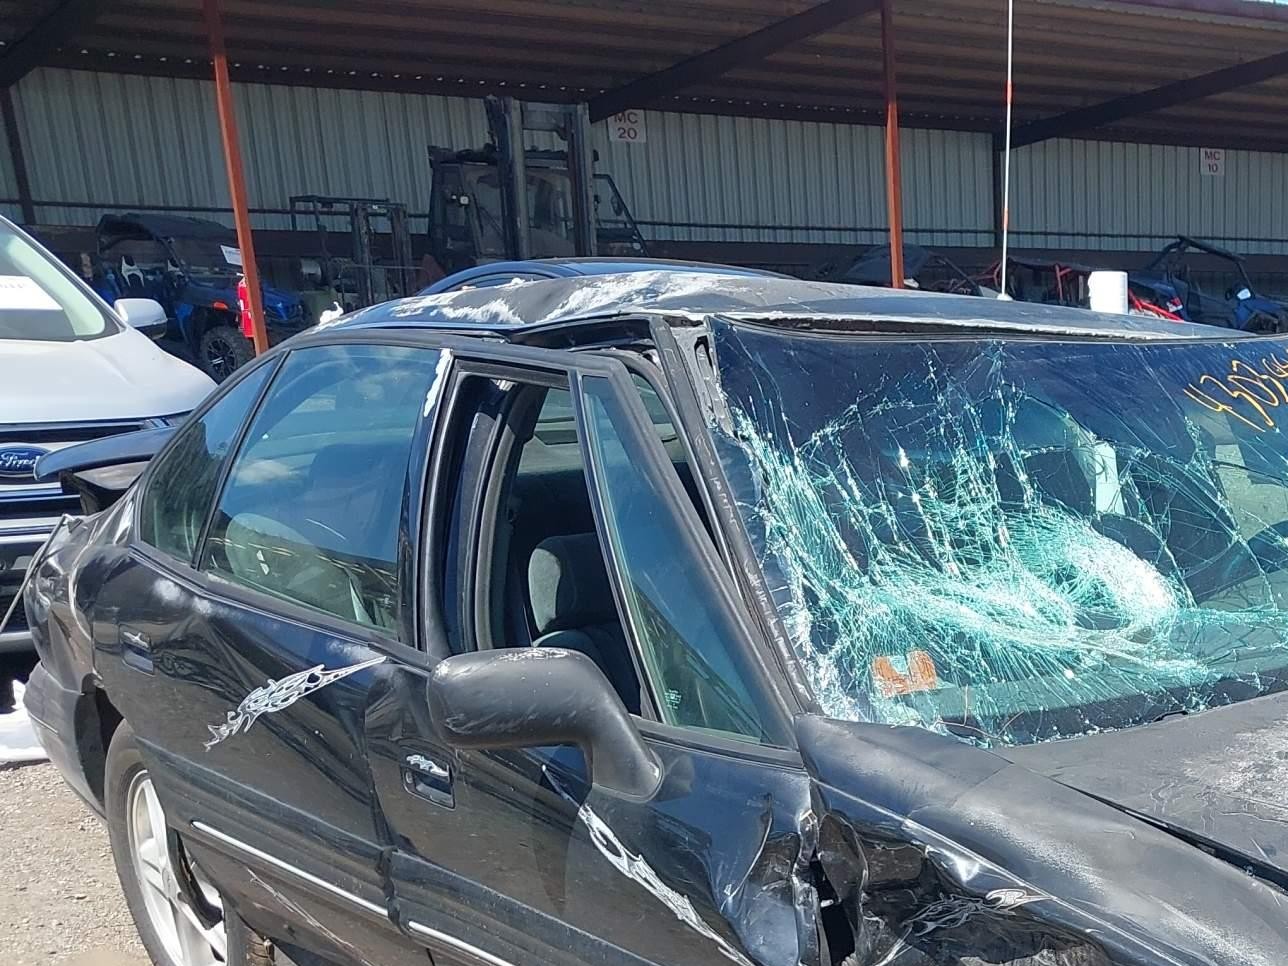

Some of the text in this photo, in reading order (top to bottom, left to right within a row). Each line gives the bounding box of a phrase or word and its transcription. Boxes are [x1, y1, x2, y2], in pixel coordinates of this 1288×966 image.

[615, 112, 638, 124] MC
[618, 127, 638, 140] 20
[1205, 151, 1221, 161] MC
[1208, 163, 1219, 173] 10
